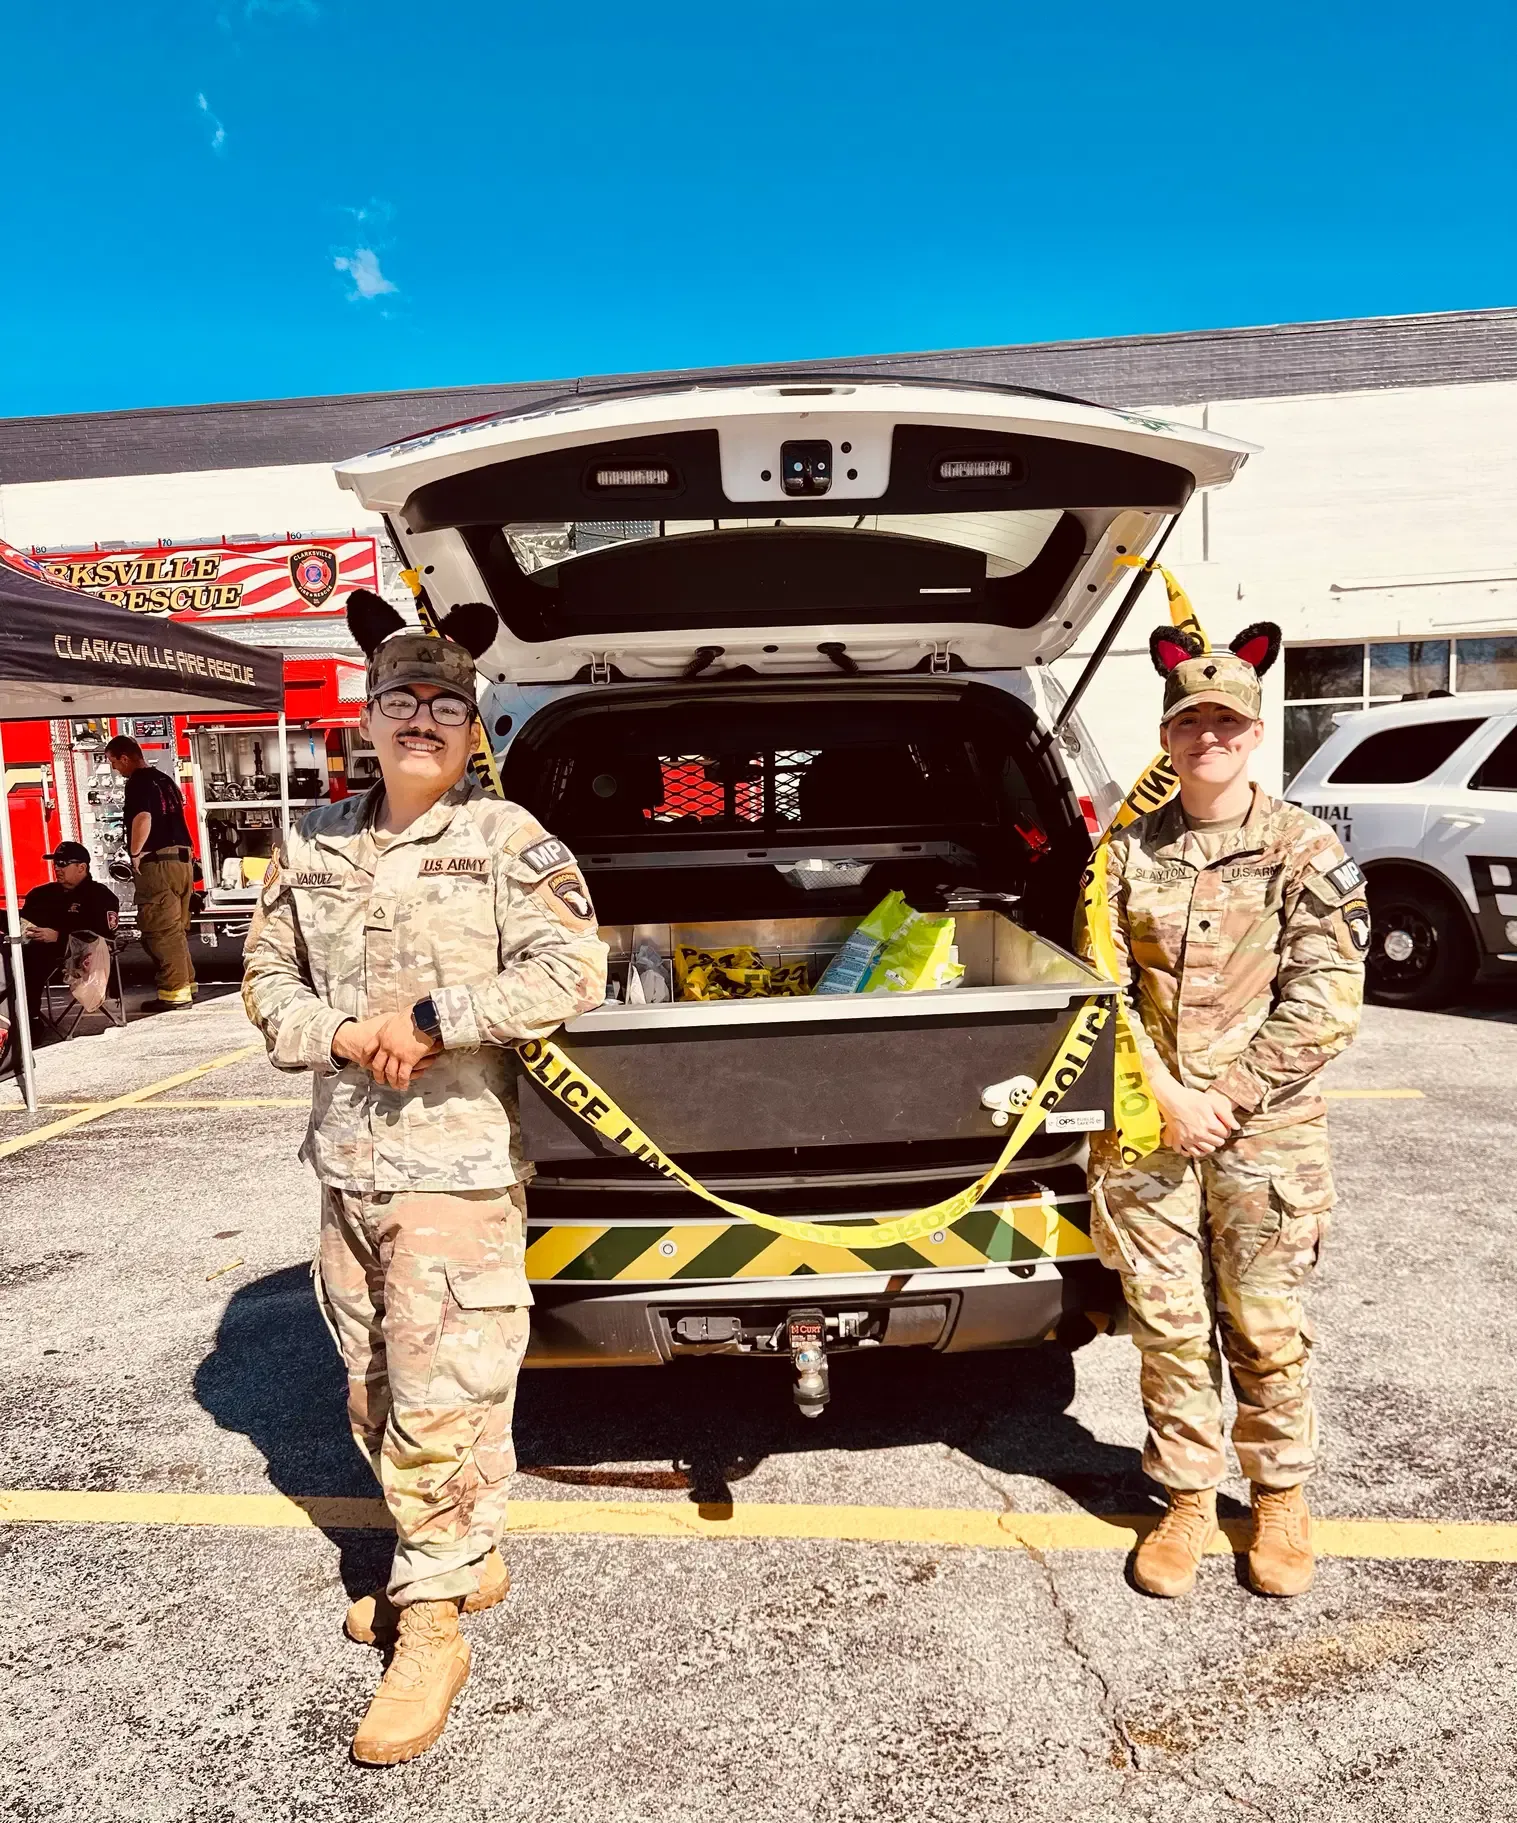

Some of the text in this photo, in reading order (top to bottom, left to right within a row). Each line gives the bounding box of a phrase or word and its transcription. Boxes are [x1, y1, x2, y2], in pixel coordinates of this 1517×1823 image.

[162, 538, 173, 547] 70
[290, 531, 302, 540] 60
[35, 546, 47, 554] 80
[293, 550, 333, 561] CLARKSVILLE
[45, 556, 220, 588] RKSVILLE
[101, 584, 243, 612] RESCUE
[313, 585, 333, 598] RESCUE
[54, 634, 177, 671] CLARKSVILLE
[206, 657, 257, 687] RESCUE
[1312, 806, 1353, 821] DIAL
[528, 841, 561, 869] MP
[423, 858, 487, 873] U.S. ARMY
[1231, 867, 1253, 878] U.S.
[1135, 867, 1187, 880] SLAYTON
[1333, 861, 1360, 891] MP
[1039, 1012, 1103, 1112] POLIC
[519, 1039, 610, 1126] OLICE
[800, 1325, 821, 1334] CURT
